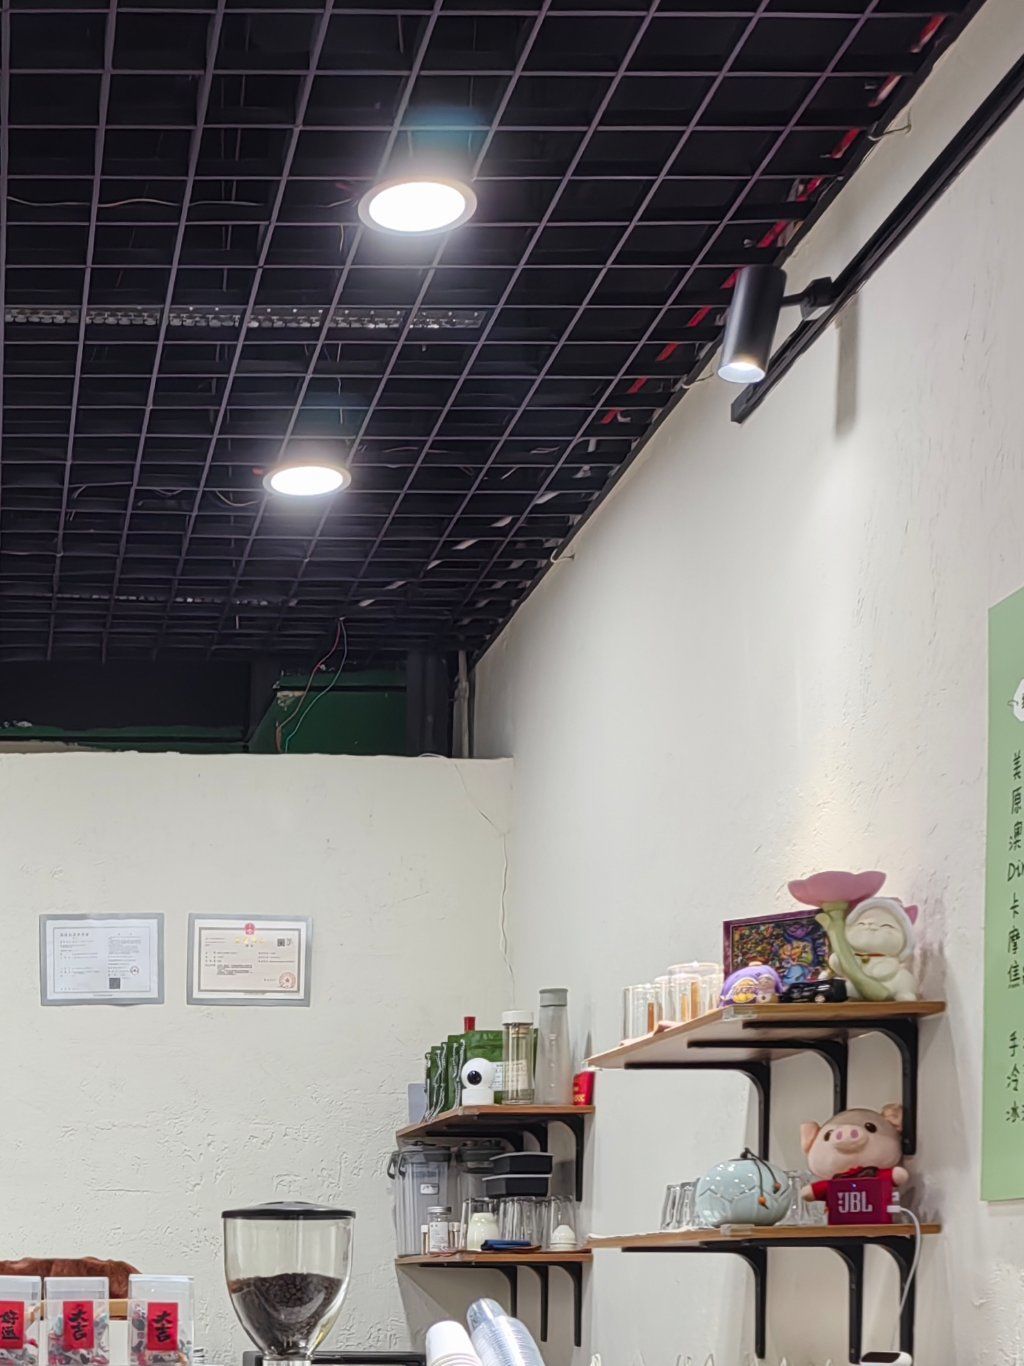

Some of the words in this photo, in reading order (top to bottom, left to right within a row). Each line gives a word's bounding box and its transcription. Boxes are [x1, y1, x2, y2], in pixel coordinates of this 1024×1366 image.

[1007, 859, 1024, 882] Di
[837, 1191, 873, 1213] JBL
[65, 1308, 89, 1342] 大吉
[151, 1310, 174, 1343] 大吉
